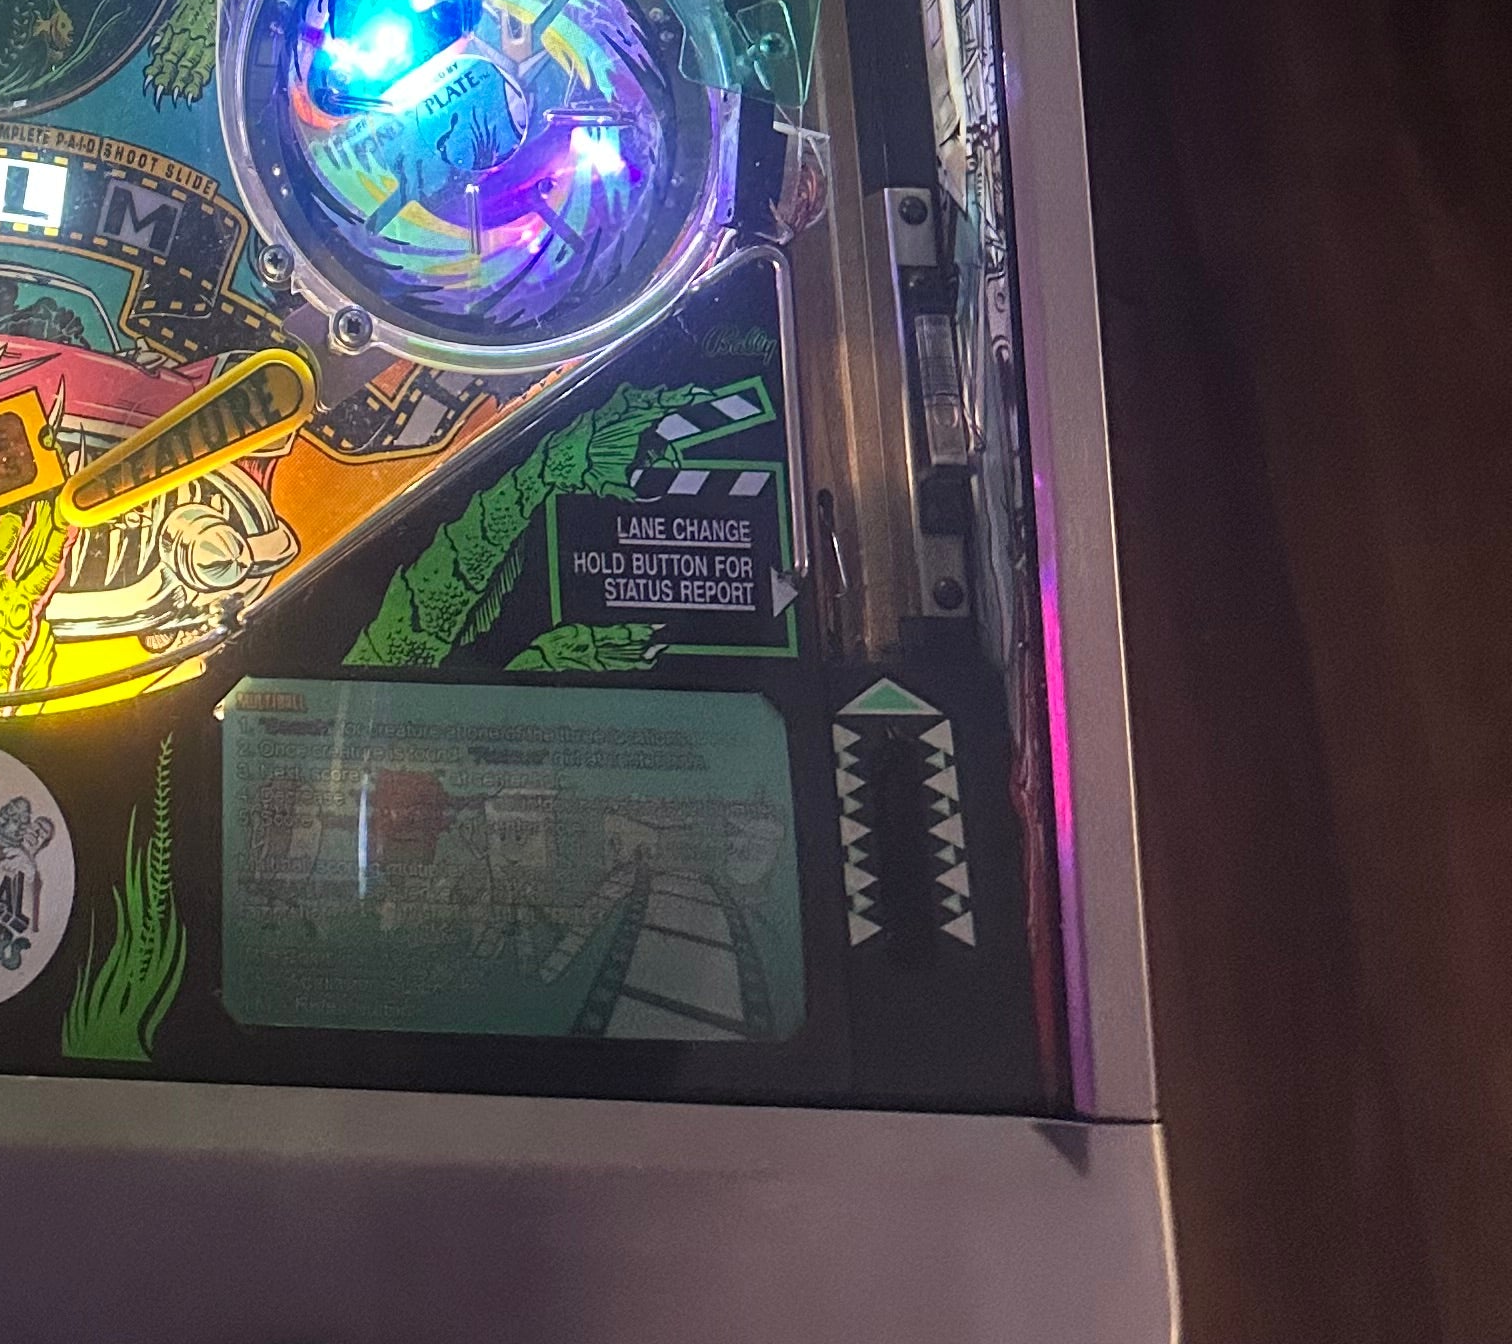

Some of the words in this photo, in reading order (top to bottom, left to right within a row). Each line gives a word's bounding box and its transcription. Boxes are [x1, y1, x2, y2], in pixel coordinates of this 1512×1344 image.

[102, 142, 159, 174] SHOOT
[164, 163, 215, 195] SLIDE
[617, 515, 667, 540] LANE
[673, 517, 752, 543] CHANGE
[574, 551, 626, 575] HOLD
[631, 552, 711, 578] BUTTON
[714, 554, 754, 580] FOR
[604, 577, 675, 602] STATUS
[679, 580, 755, 605] REPORT
